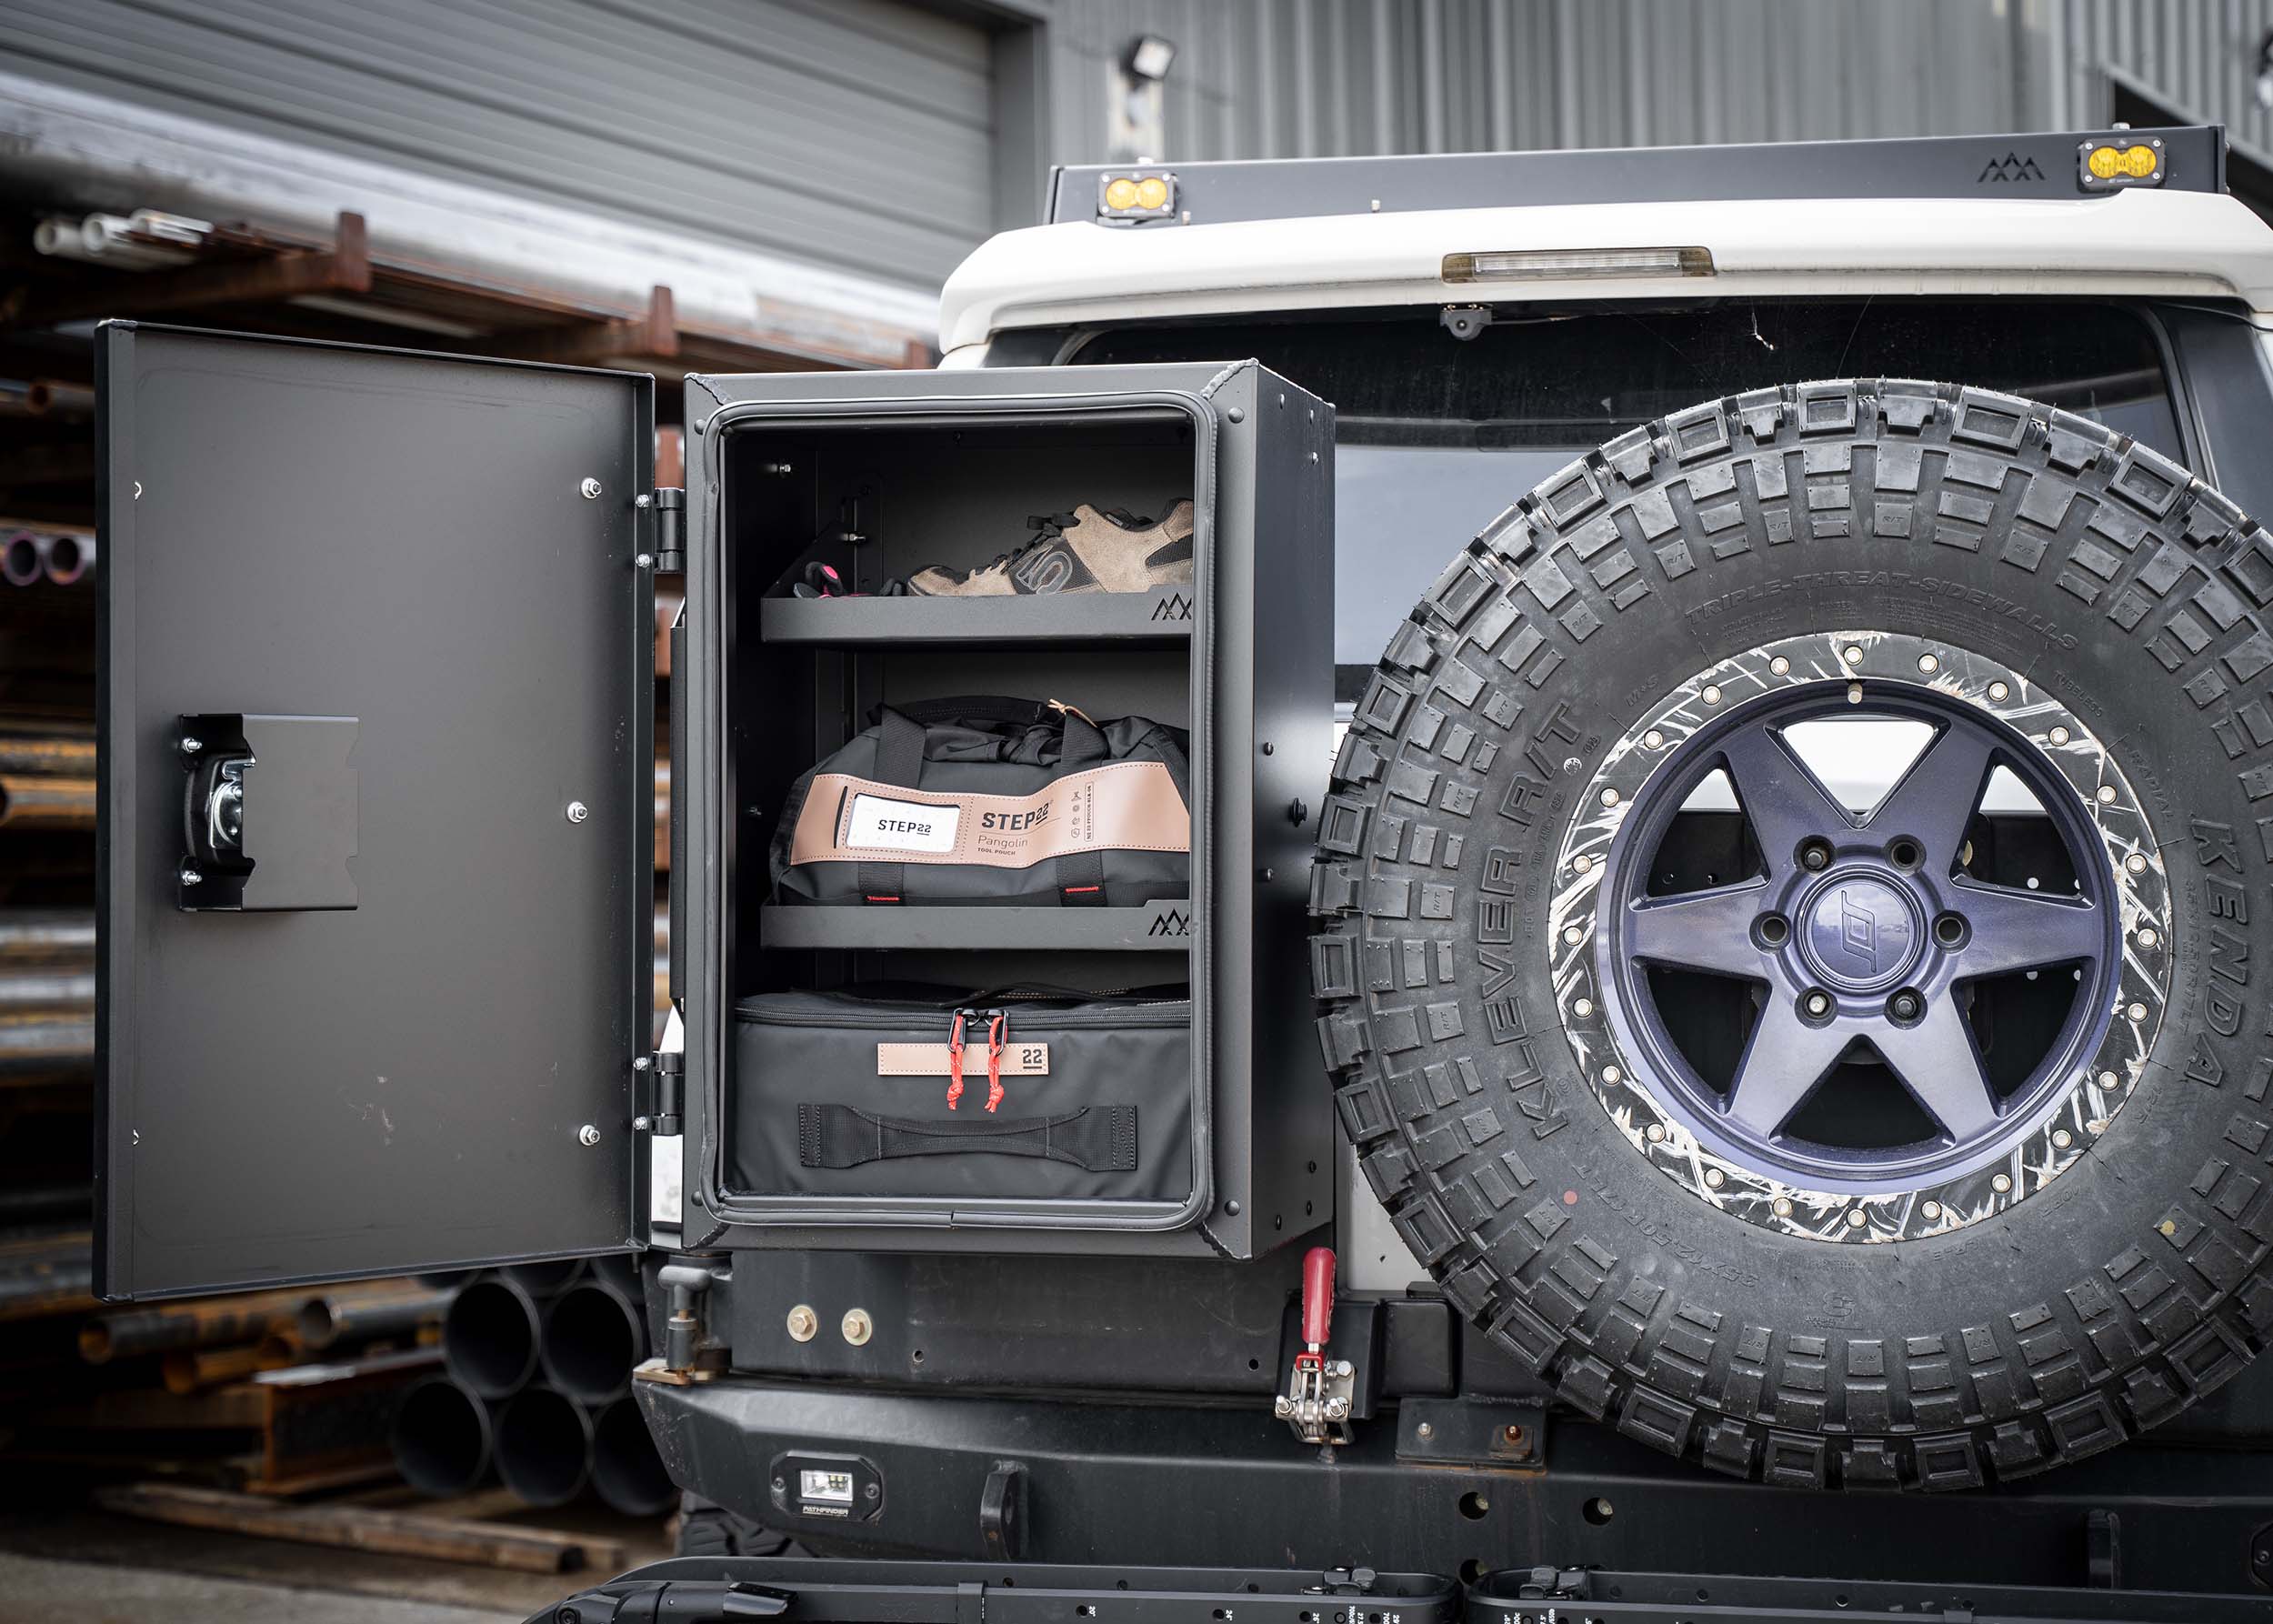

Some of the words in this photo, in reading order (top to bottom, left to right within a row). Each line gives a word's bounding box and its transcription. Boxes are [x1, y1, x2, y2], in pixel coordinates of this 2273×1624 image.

[1497, 701, 1581, 827] R/T
[877, 819, 932, 836] STEP22
[981, 803, 1049, 831] STEP22
[977, 835, 1028, 849] Pangolin
[2183, 816, 2251, 1088] KENDA
[1477, 846, 1569, 1142] KLEVER
[1023, 1048, 1043, 1064] 22
